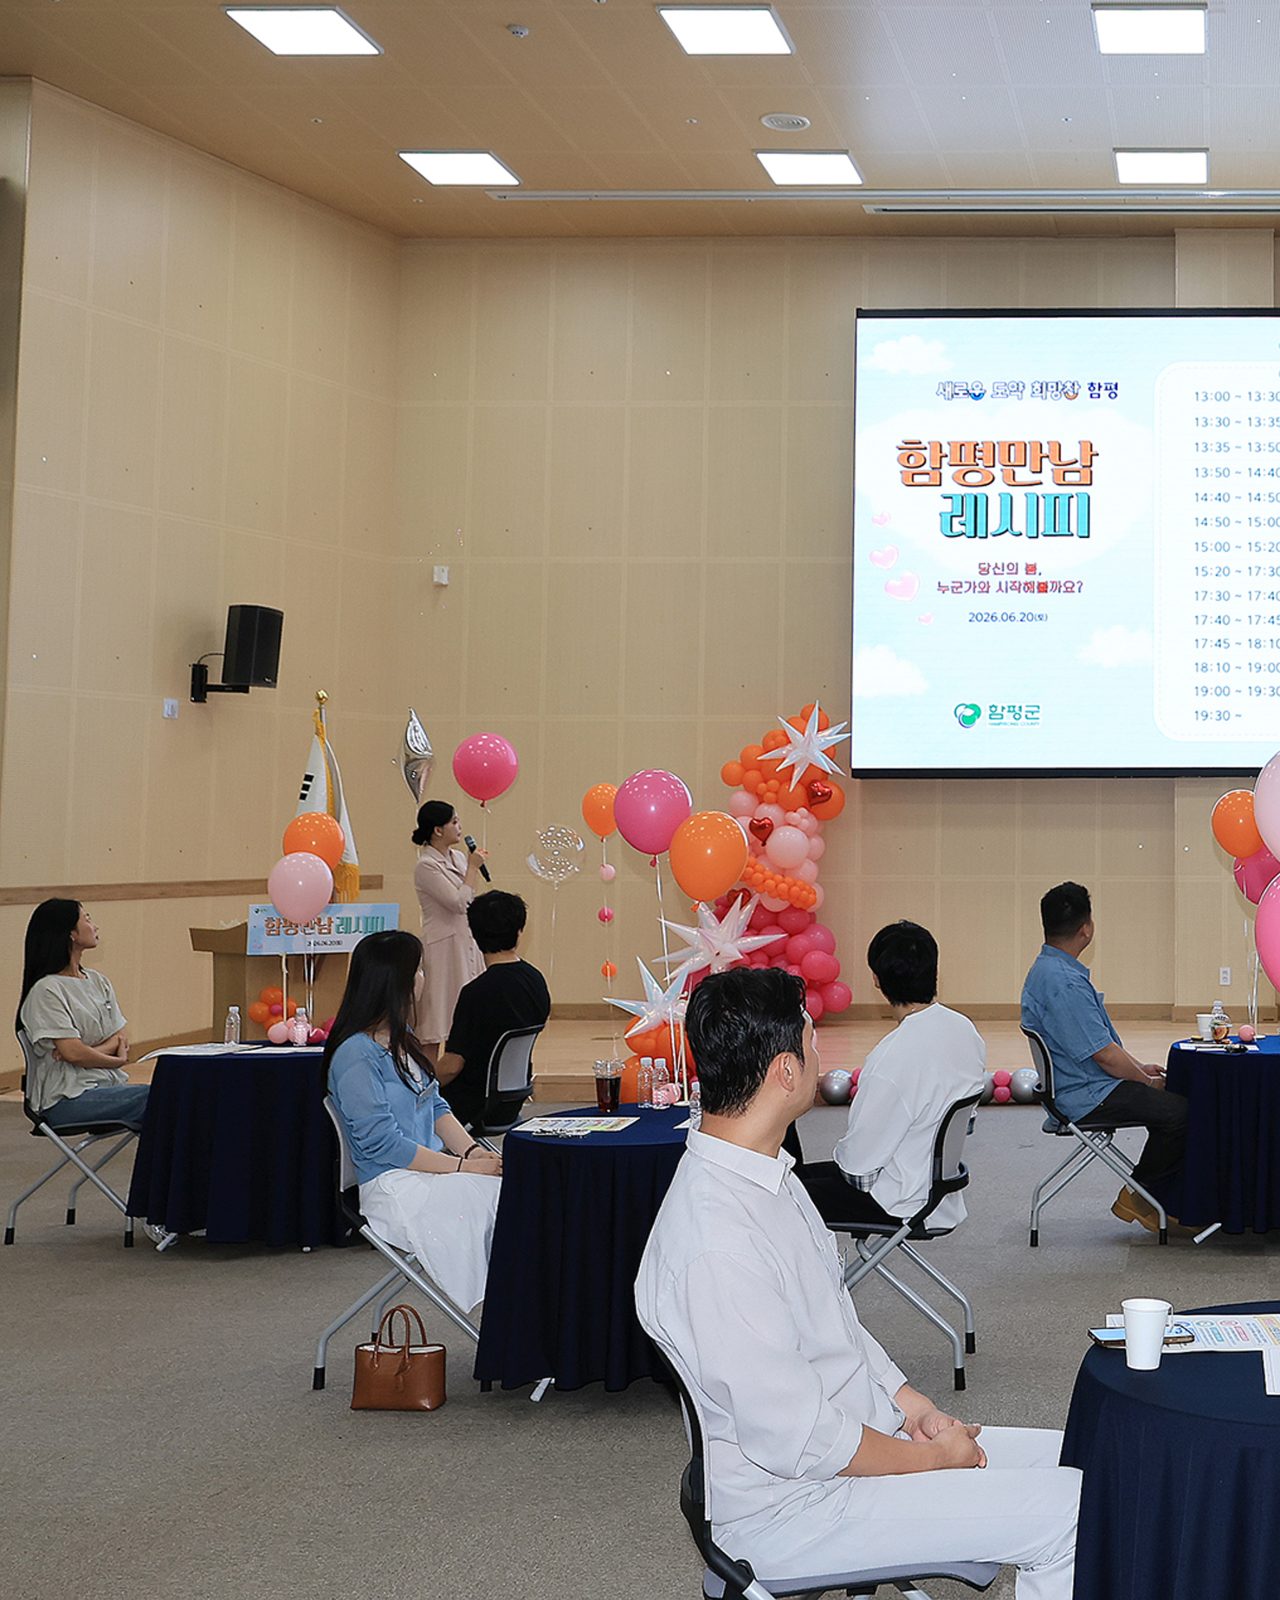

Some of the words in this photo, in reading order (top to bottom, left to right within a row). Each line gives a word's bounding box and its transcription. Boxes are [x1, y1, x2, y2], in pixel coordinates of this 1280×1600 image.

[936, 381, 987, 401] 새로운
[990, 381, 1026, 401] 도약
[1030, 381, 1081, 401] 희망찬
[1087, 382, 1119, 400] 함평
[1195, 391, 1231, 402] 13:00
[1195, 416, 1231, 428] 13:30
[1195, 442, 1230, 453] 13:35
[896, 439, 1100, 488] 함평만남
[1195, 467, 1230, 478] 13:50
[1195, 492, 1230, 503] 14:40
[938, 492, 1092, 539] 레시피
[1195, 516, 1231, 528] 14:50
[1195, 541, 1230, 552] 15:00
[977, 562, 1019, 576] 당신의
[1195, 564, 1232, 577] 15:20
[937, 580, 991, 594] 누군가와
[1195, 590, 1231, 602] 17:30
[1195, 614, 1231, 626] 17:40
[1195, 638, 1230, 650] 17:45
[1194, 662, 1230, 673] 18:10
[1195, 685, 1231, 697] 19:00
[988, 704, 1040, 721] 함평군
[1194, 710, 1231, 721] 19:30
